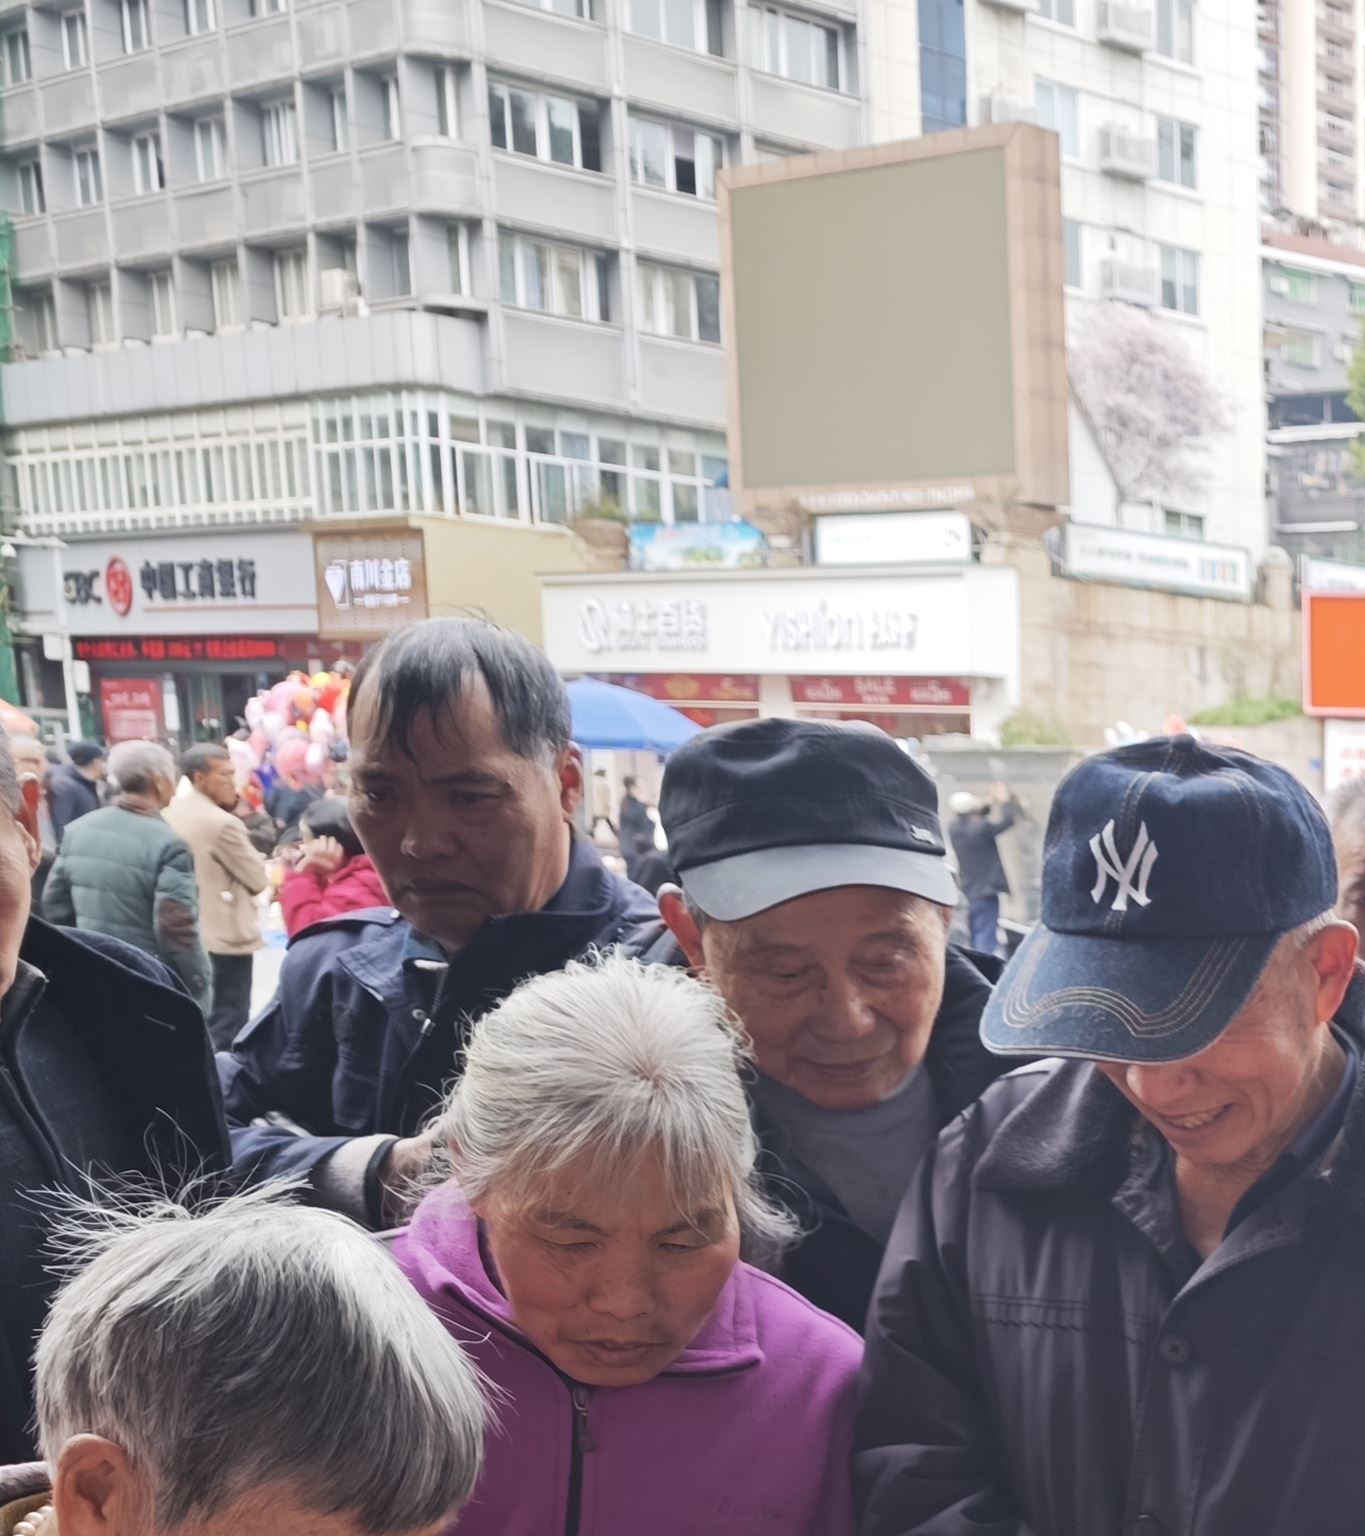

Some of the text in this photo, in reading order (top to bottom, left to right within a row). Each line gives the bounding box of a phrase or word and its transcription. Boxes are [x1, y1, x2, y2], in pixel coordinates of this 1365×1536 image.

[140, 557, 256, 600] 中国工商银行
[350, 557, 412, 591] 南川金店
